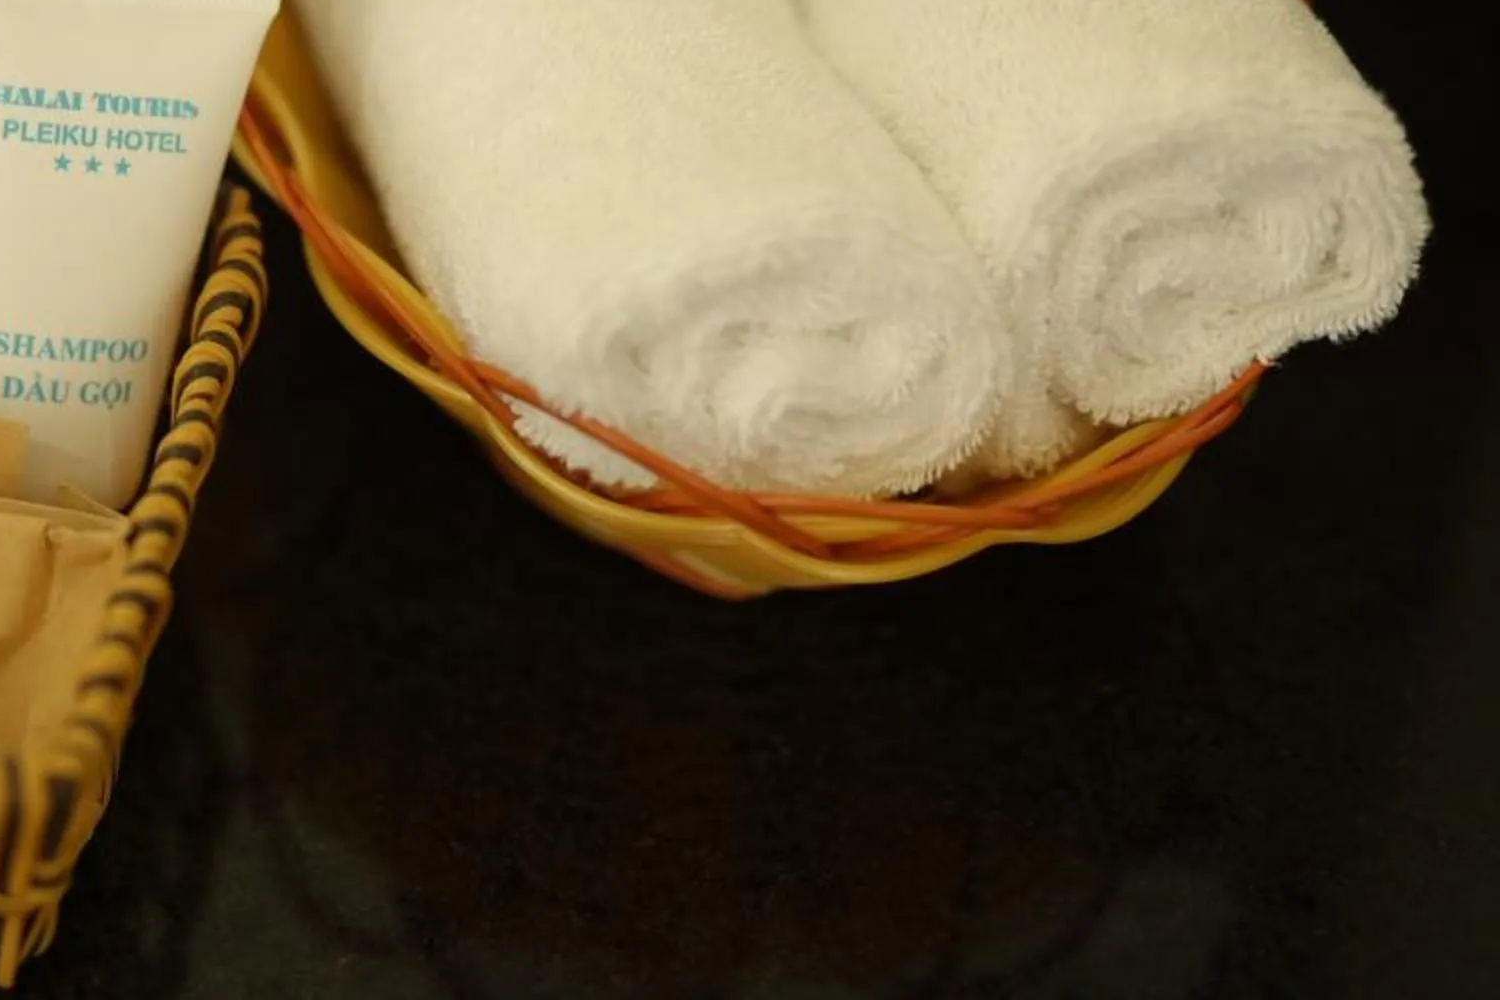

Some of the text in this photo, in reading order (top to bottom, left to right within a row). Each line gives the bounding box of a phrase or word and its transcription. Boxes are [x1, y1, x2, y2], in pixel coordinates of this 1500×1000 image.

[93, 91, 199, 119] TOURIS
[2, 119, 187, 153] PLEIKU HOTEL
